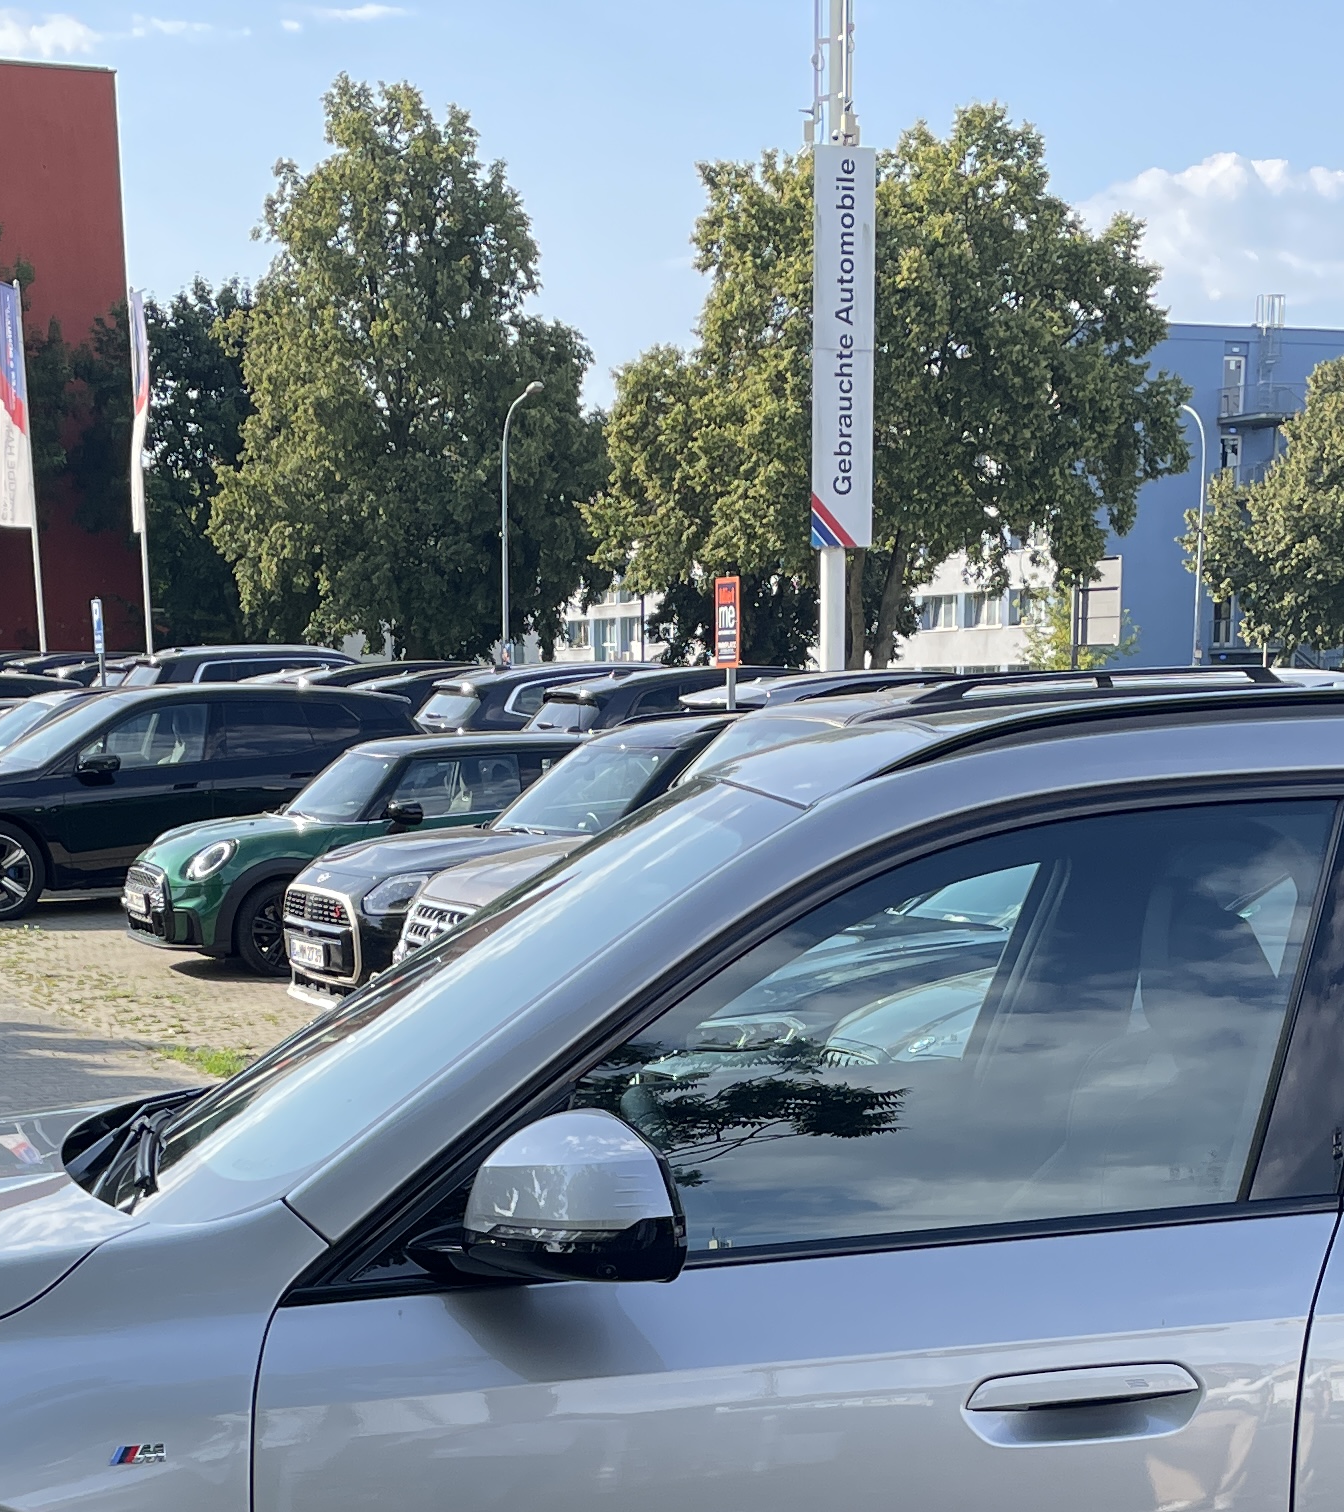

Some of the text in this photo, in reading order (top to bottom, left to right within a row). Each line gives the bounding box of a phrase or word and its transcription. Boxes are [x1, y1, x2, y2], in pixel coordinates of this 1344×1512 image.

[833, 158, 856, 496] Gebrauchte Automobile
[718, 605, 736, 629] me
